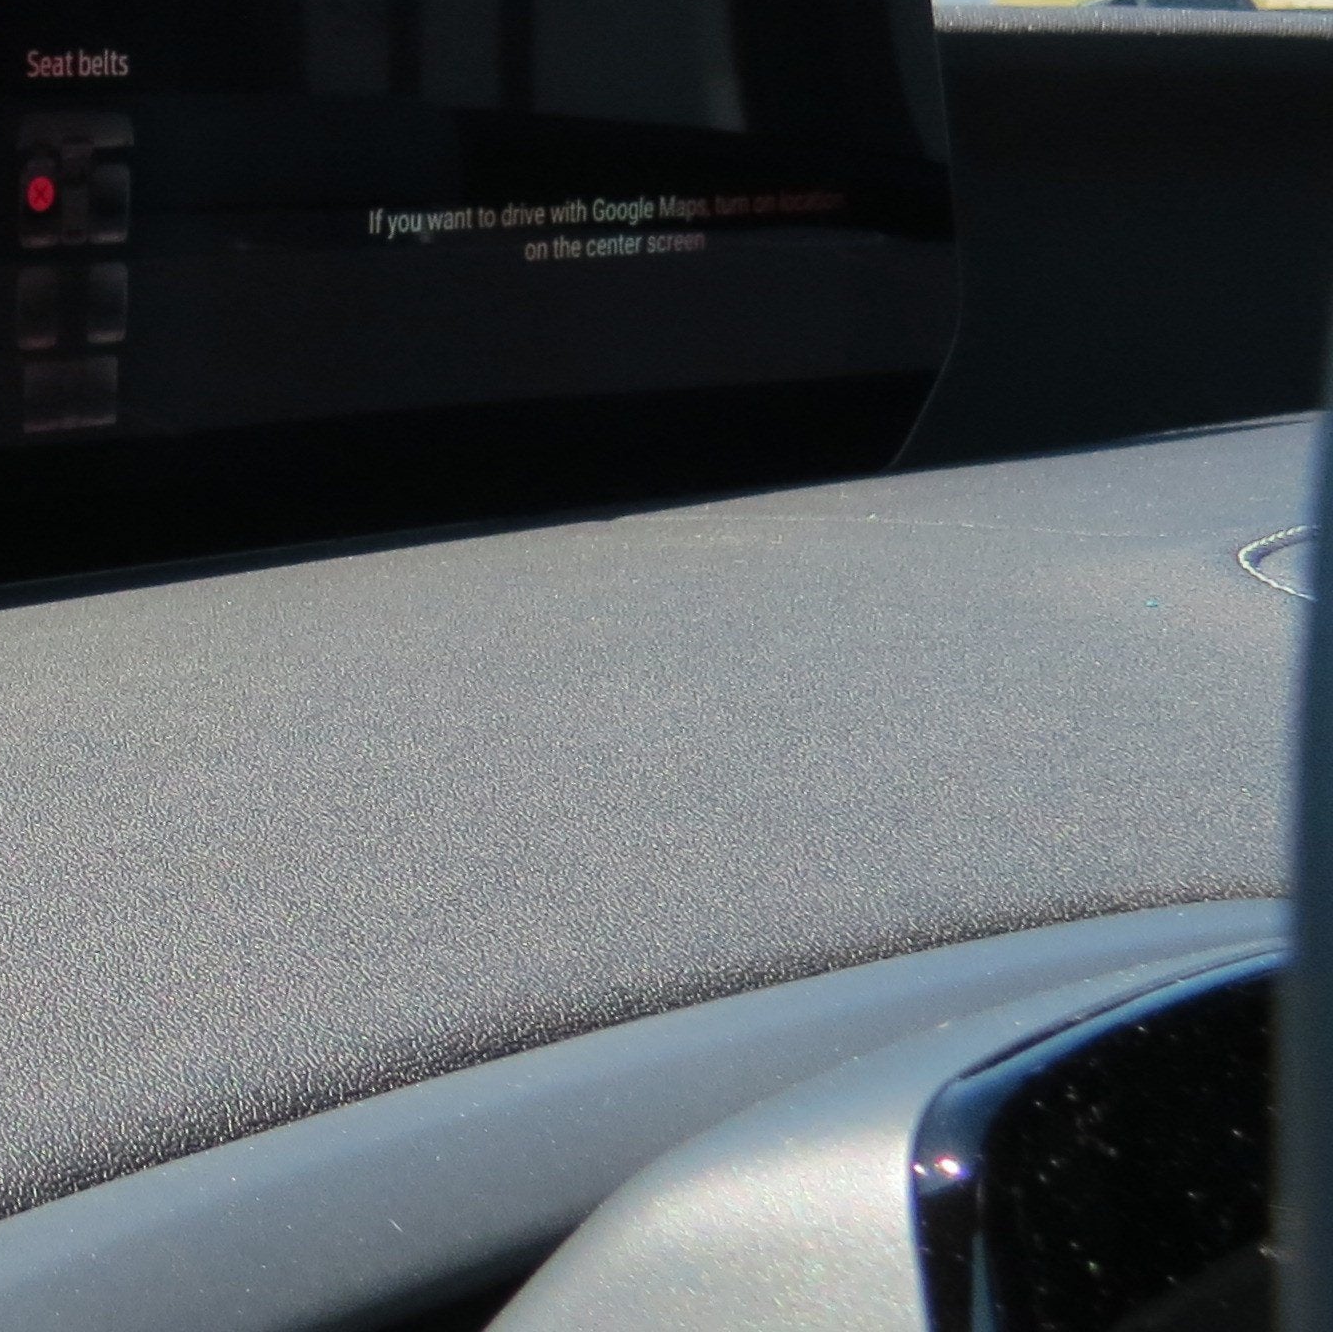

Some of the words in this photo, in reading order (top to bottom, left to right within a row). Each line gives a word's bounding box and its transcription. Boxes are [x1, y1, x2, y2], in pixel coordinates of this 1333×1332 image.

[25, 48, 74, 78] Seat
[78, 46, 130, 77] belts
[368, 208, 384, 235] If
[387, 213, 422, 240] you
[427, 208, 473, 232] want
[478, 206, 496, 229] to
[500, 202, 545, 227] drive
[550, 198, 587, 224] with
[592, 196, 654, 227] Google
[524, 241, 549, 261] on
[553, 235, 582, 260] the
[586, 233, 642, 258] center
[647, 231, 705, 254] screen
